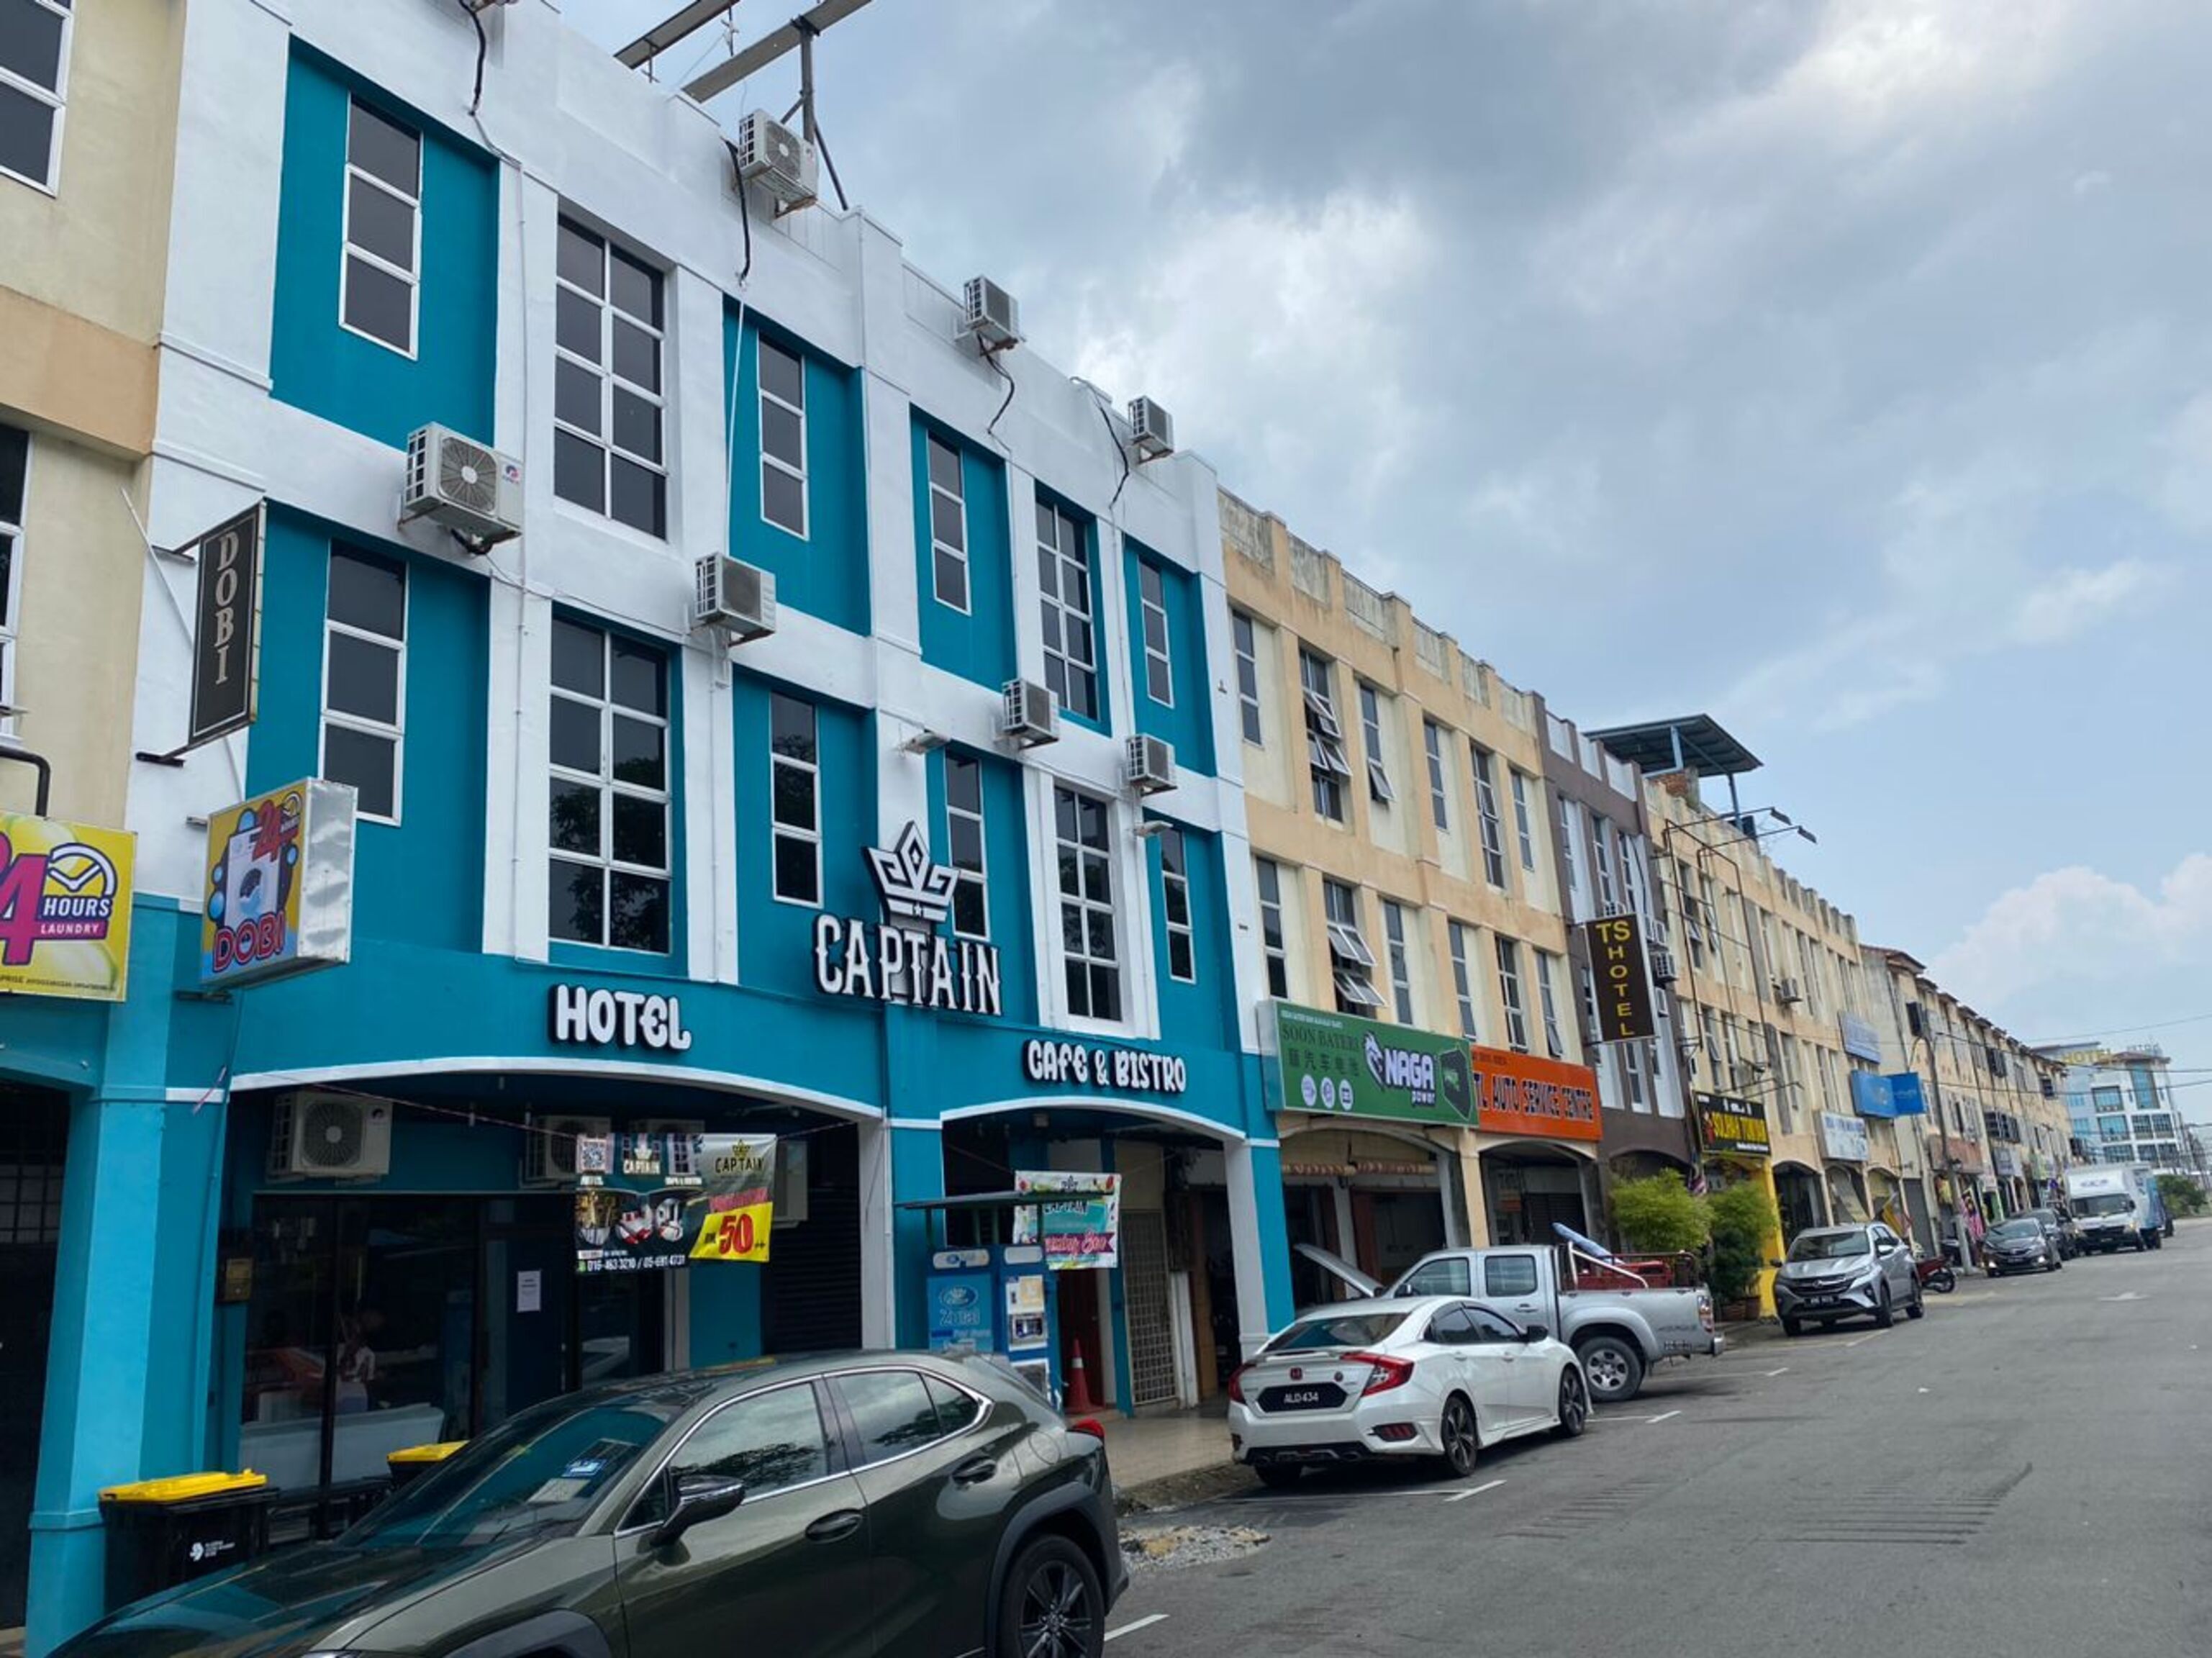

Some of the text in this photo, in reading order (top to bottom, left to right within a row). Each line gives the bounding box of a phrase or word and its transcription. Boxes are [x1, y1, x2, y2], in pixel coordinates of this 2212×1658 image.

[214, 531, 239, 684] DOBI
[40, 923, 99, 934] LAUNDRY
[43, 897, 109, 918] HOURS
[1595, 920, 1631, 943] TS
[213, 911, 286, 972] DOBI
[817, 914, 1001, 1015] CAPTAIN
[1608, 946, 1635, 1036] HOTEL
[556, 984, 692, 1049] HOTEL
[1029, 1040, 1187, 1092] CAFE & BISTRO
[1384, 1048, 1436, 1091] NAGA
[1492, 1074, 1520, 1113] AUTO
[1521, 1079, 1561, 1118] SERVICE
[1561, 1086, 1595, 1123] CENTRE
[715, 1157, 764, 1174] CAPTAIN
[719, 1213, 754, 1254] 50
